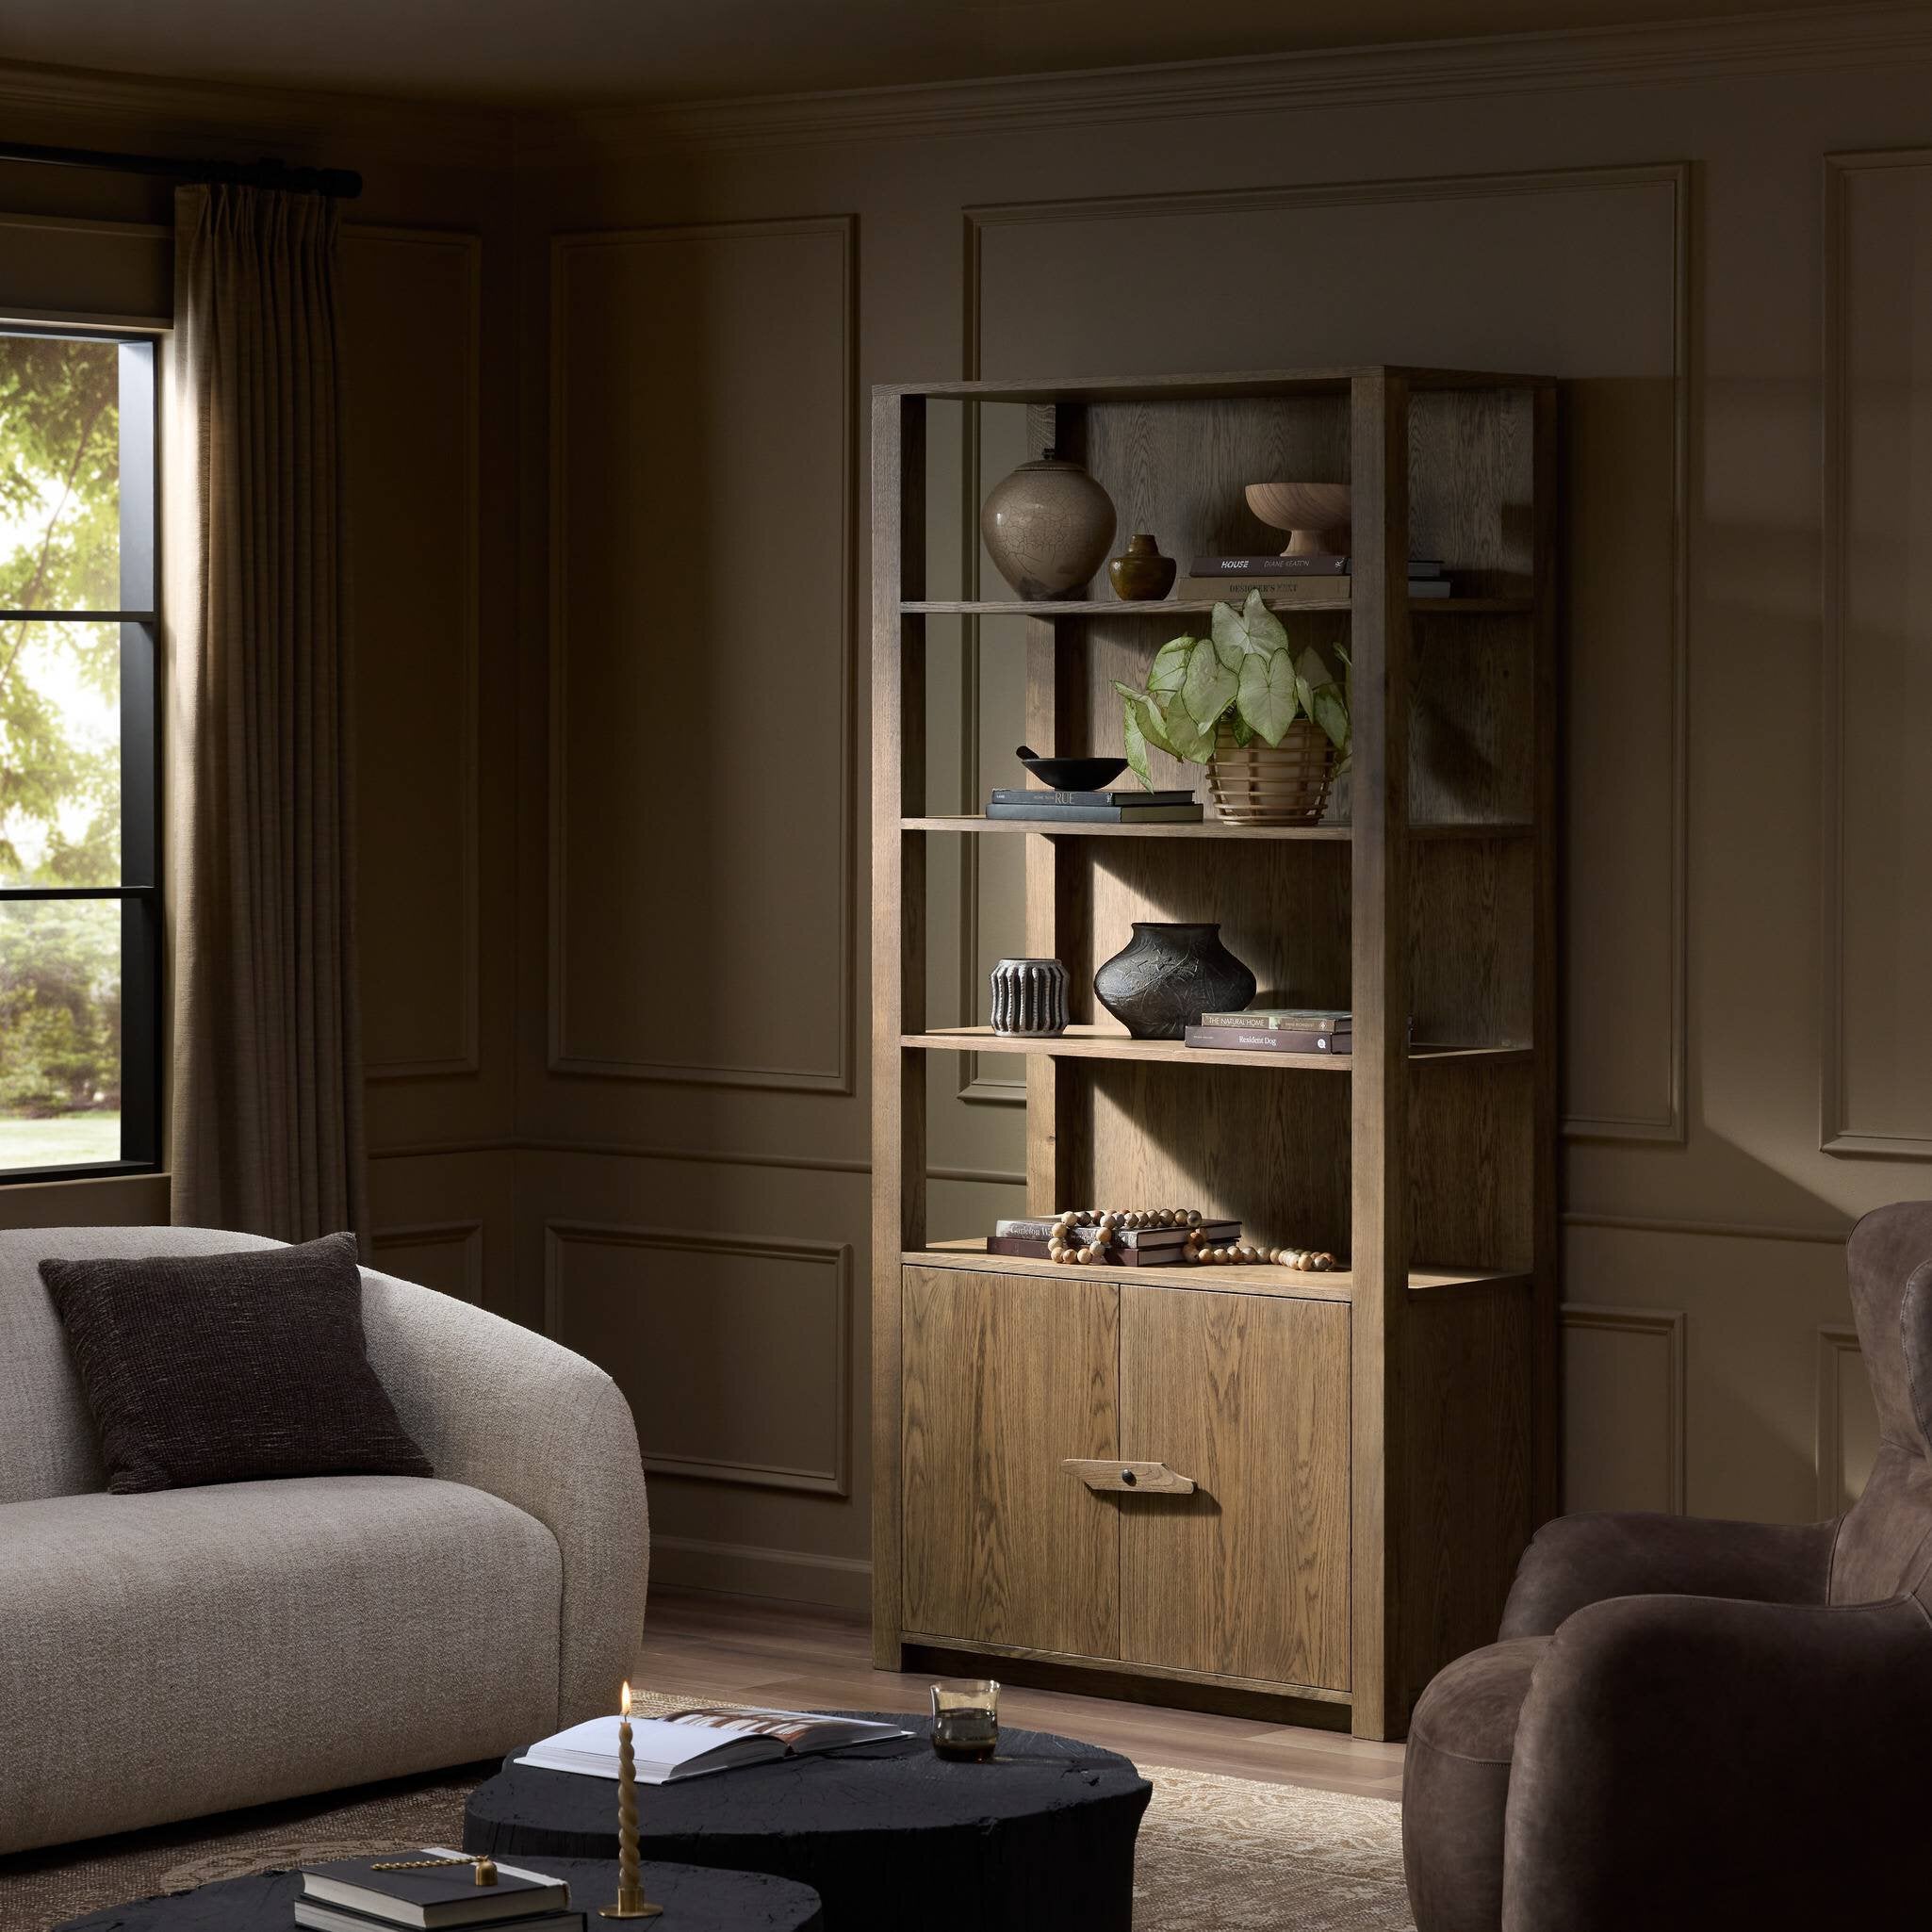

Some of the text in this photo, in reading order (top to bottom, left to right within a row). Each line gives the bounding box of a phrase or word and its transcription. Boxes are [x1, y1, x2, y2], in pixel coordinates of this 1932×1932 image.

[1056, 791, 1073, 804] RUE
[1238, 1035, 1277, 1046] Resident Dog
